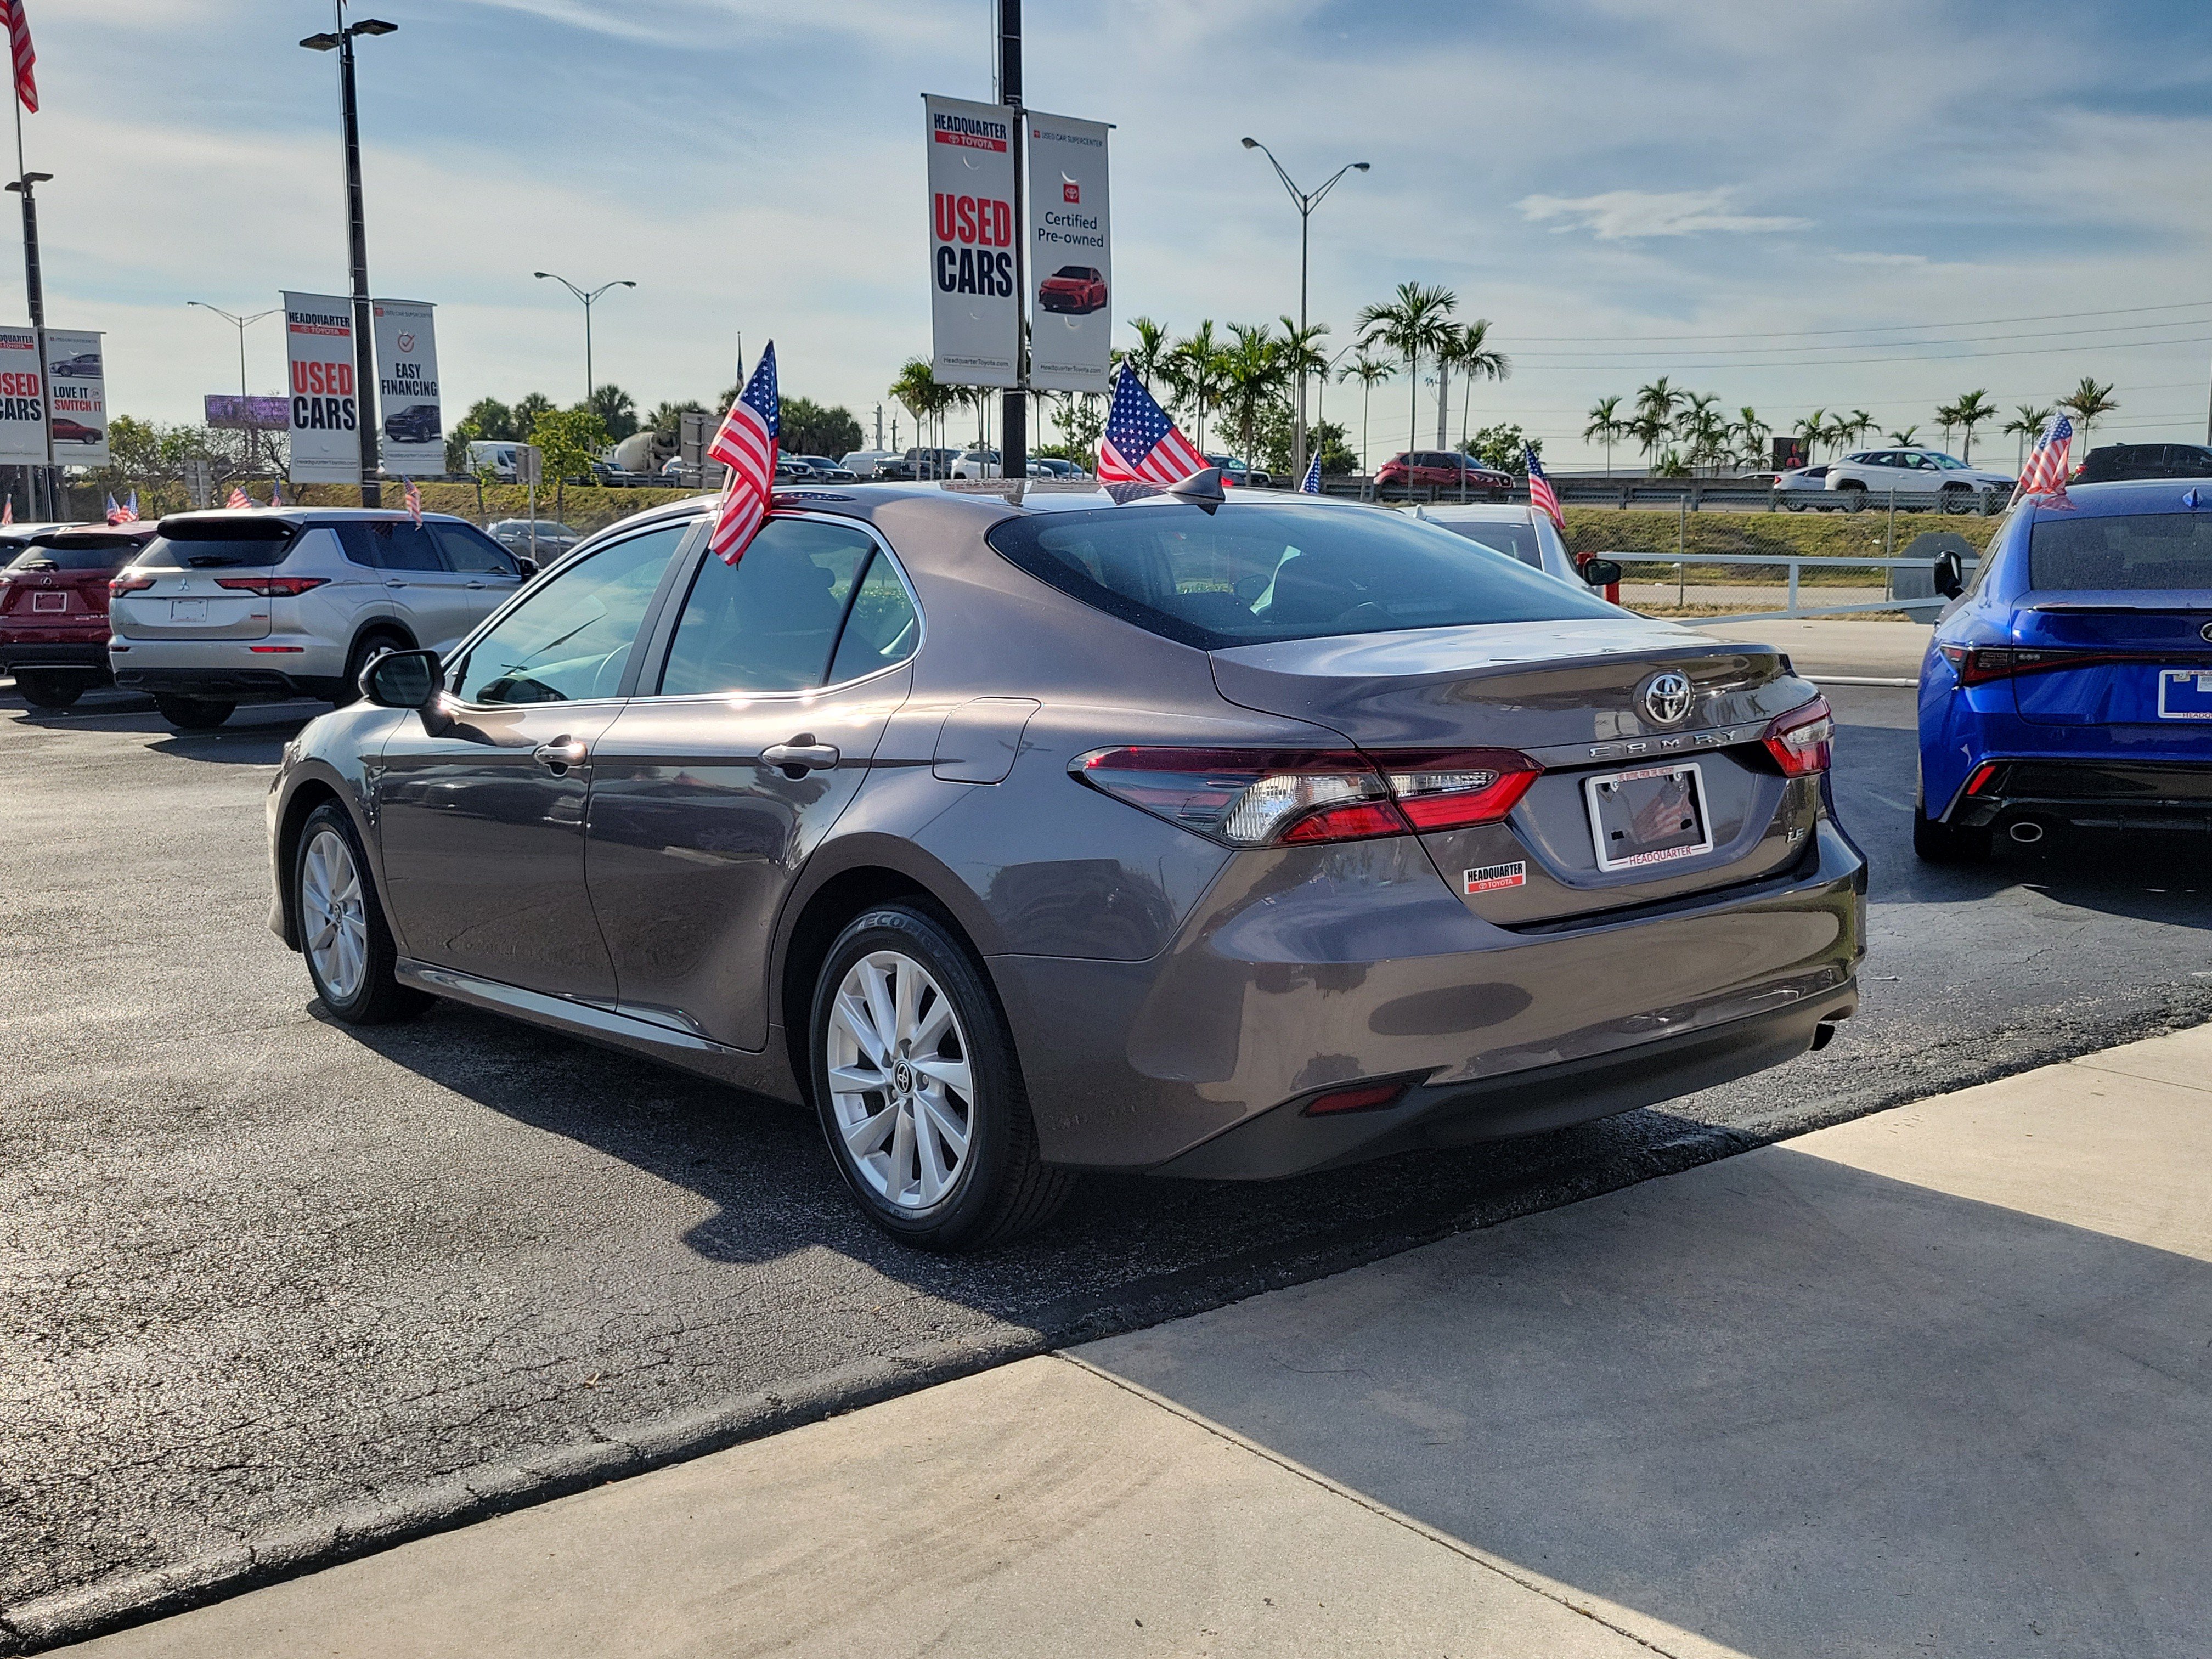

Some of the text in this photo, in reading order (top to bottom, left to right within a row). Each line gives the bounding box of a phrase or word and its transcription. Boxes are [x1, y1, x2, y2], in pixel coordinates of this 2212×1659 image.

[934, 113, 1006, 139] HEADQUARTER
[961, 136, 994, 150] TOYOTA
[935, 193, 1011, 247] USED
[1045, 211, 1097, 230] Certified
[1038, 228, 1103, 247] Pre-owned
[937, 246, 1013, 297] CARS
[289, 312, 350, 327] HEADQUARTER
[311, 326, 340, 335] TOYOTA
[396, 363, 421, 379] EASY
[944, 357, 1008, 367] HeadquarterToyota.com
[0, 372, 39, 396] SED
[292, 360, 353, 394] USED
[54, 386, 77, 398] LOVE
[80, 387, 88, 399] IT
[382, 380, 438, 396] FINANCING
[55, 399, 101, 412] SWITCH IT
[294, 396, 356, 431] CARS
[1629, 845, 1691, 865] HEADQUARTER
[1468, 862, 1523, 882] HEADQUARTER
[1488, 878, 1513, 888] TOYOTA
